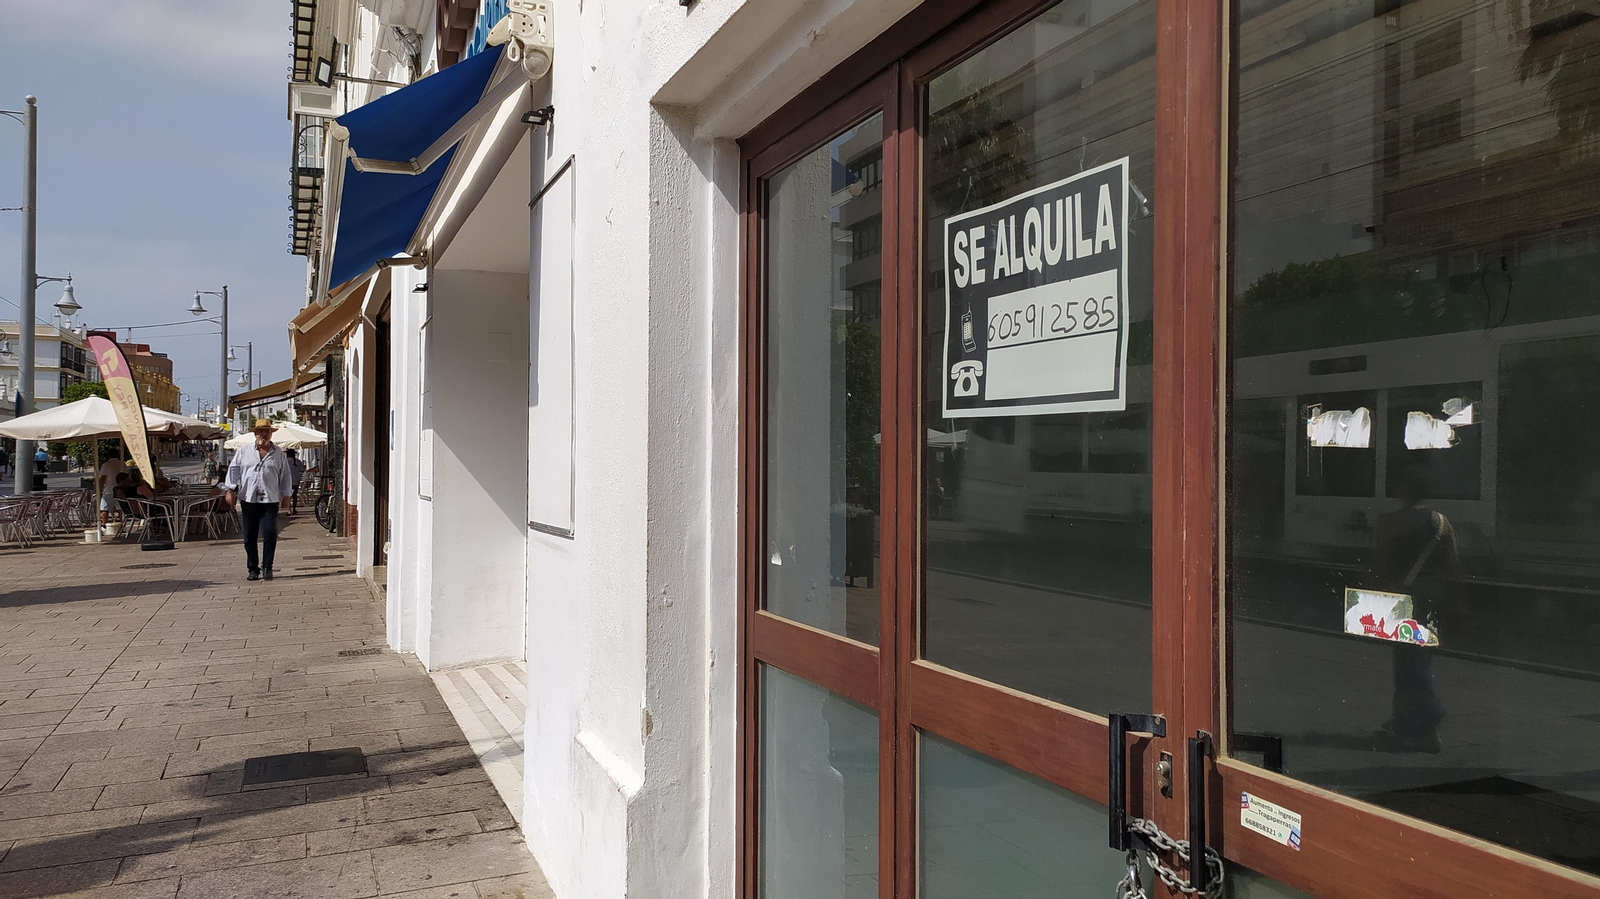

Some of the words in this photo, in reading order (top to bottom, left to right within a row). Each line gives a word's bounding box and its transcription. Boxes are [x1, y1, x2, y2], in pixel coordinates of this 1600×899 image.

[953, 225, 986, 289] SE
[993, 183, 1117, 281] ALQUILA
[987, 296, 1115, 342] 605912585
[1278, 809, 1300, 824] Ingresos
